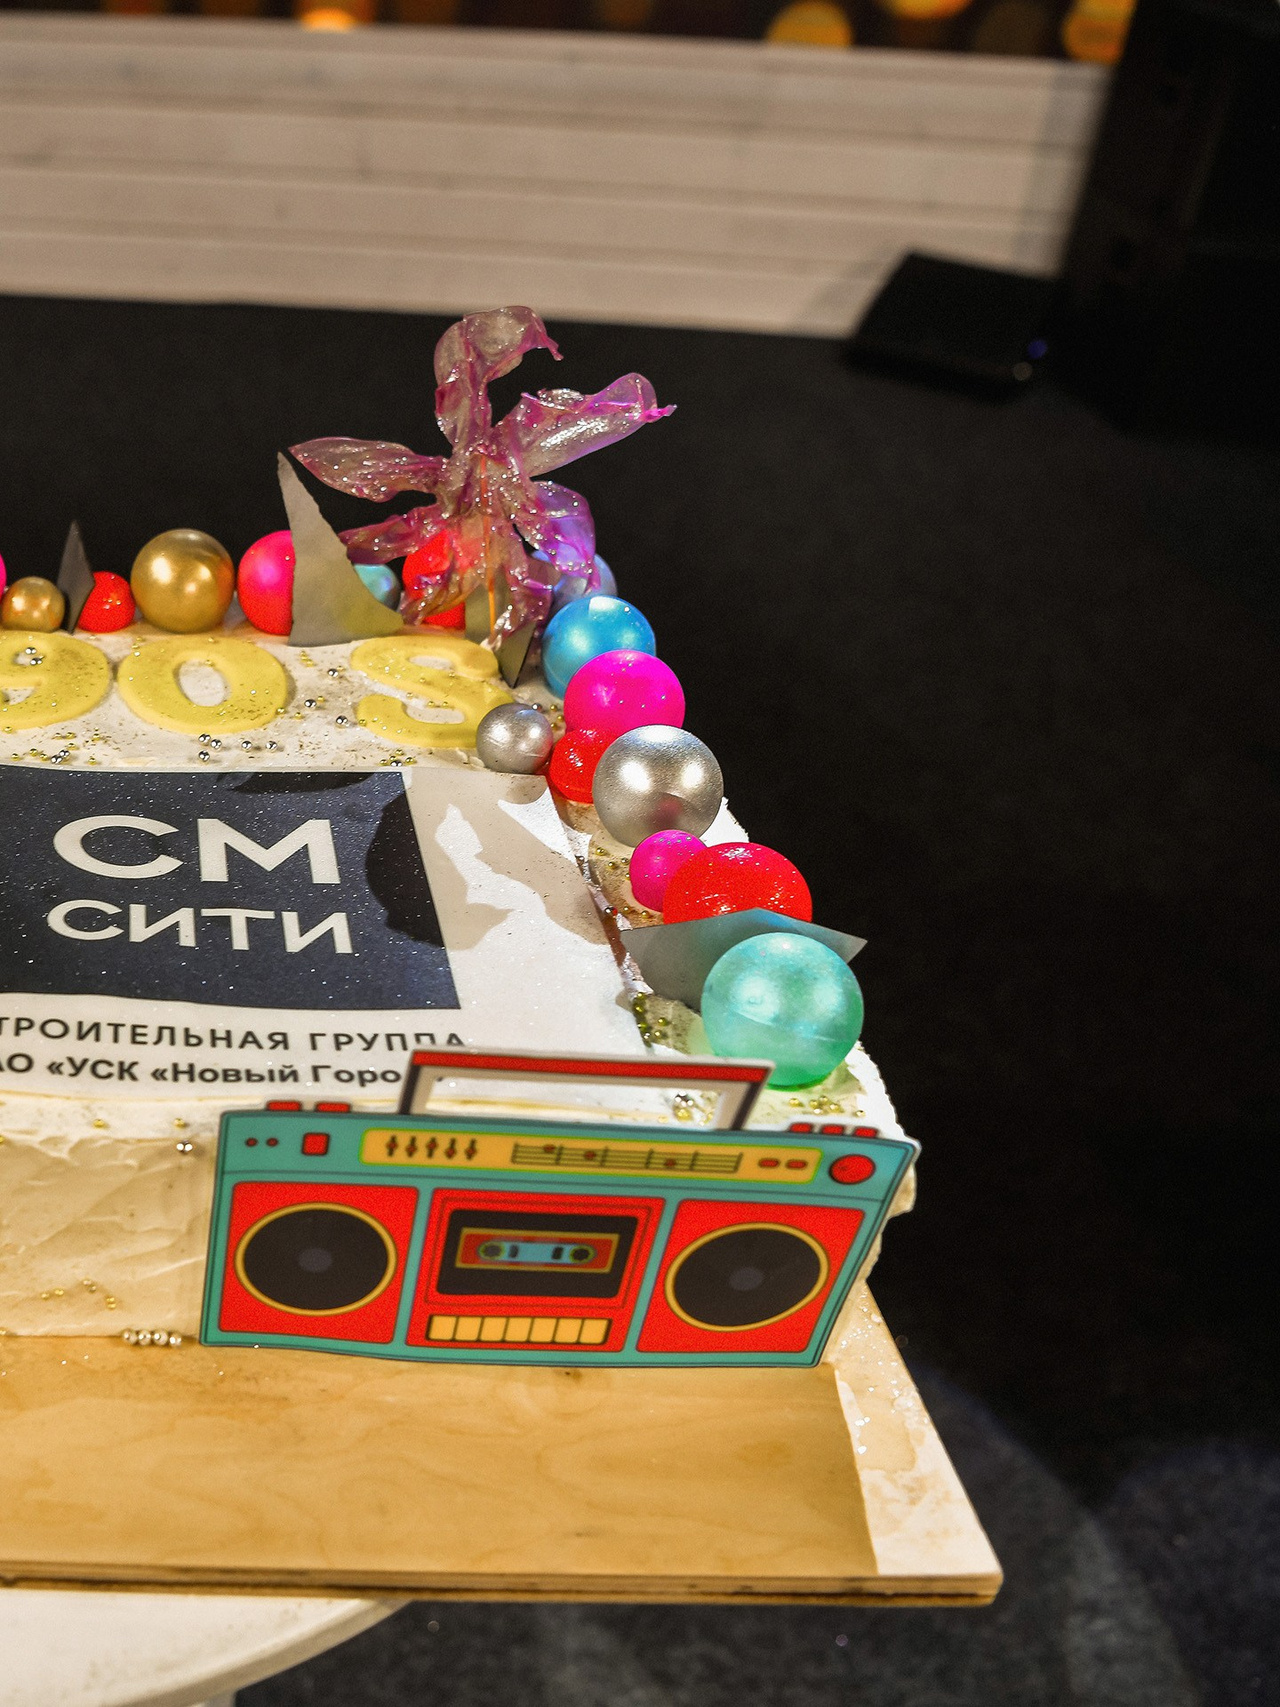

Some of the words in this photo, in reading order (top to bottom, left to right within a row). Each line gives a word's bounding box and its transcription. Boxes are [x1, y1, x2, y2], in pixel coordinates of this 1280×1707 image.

[53, 815, 341, 884] СМ
[47, 899, 353, 954] СИТИ
[46, 1056, 140, 1082] «УСК
[150, 1062, 300, 1084] «Новый
[311, 1065, 444, 1087] Горо
